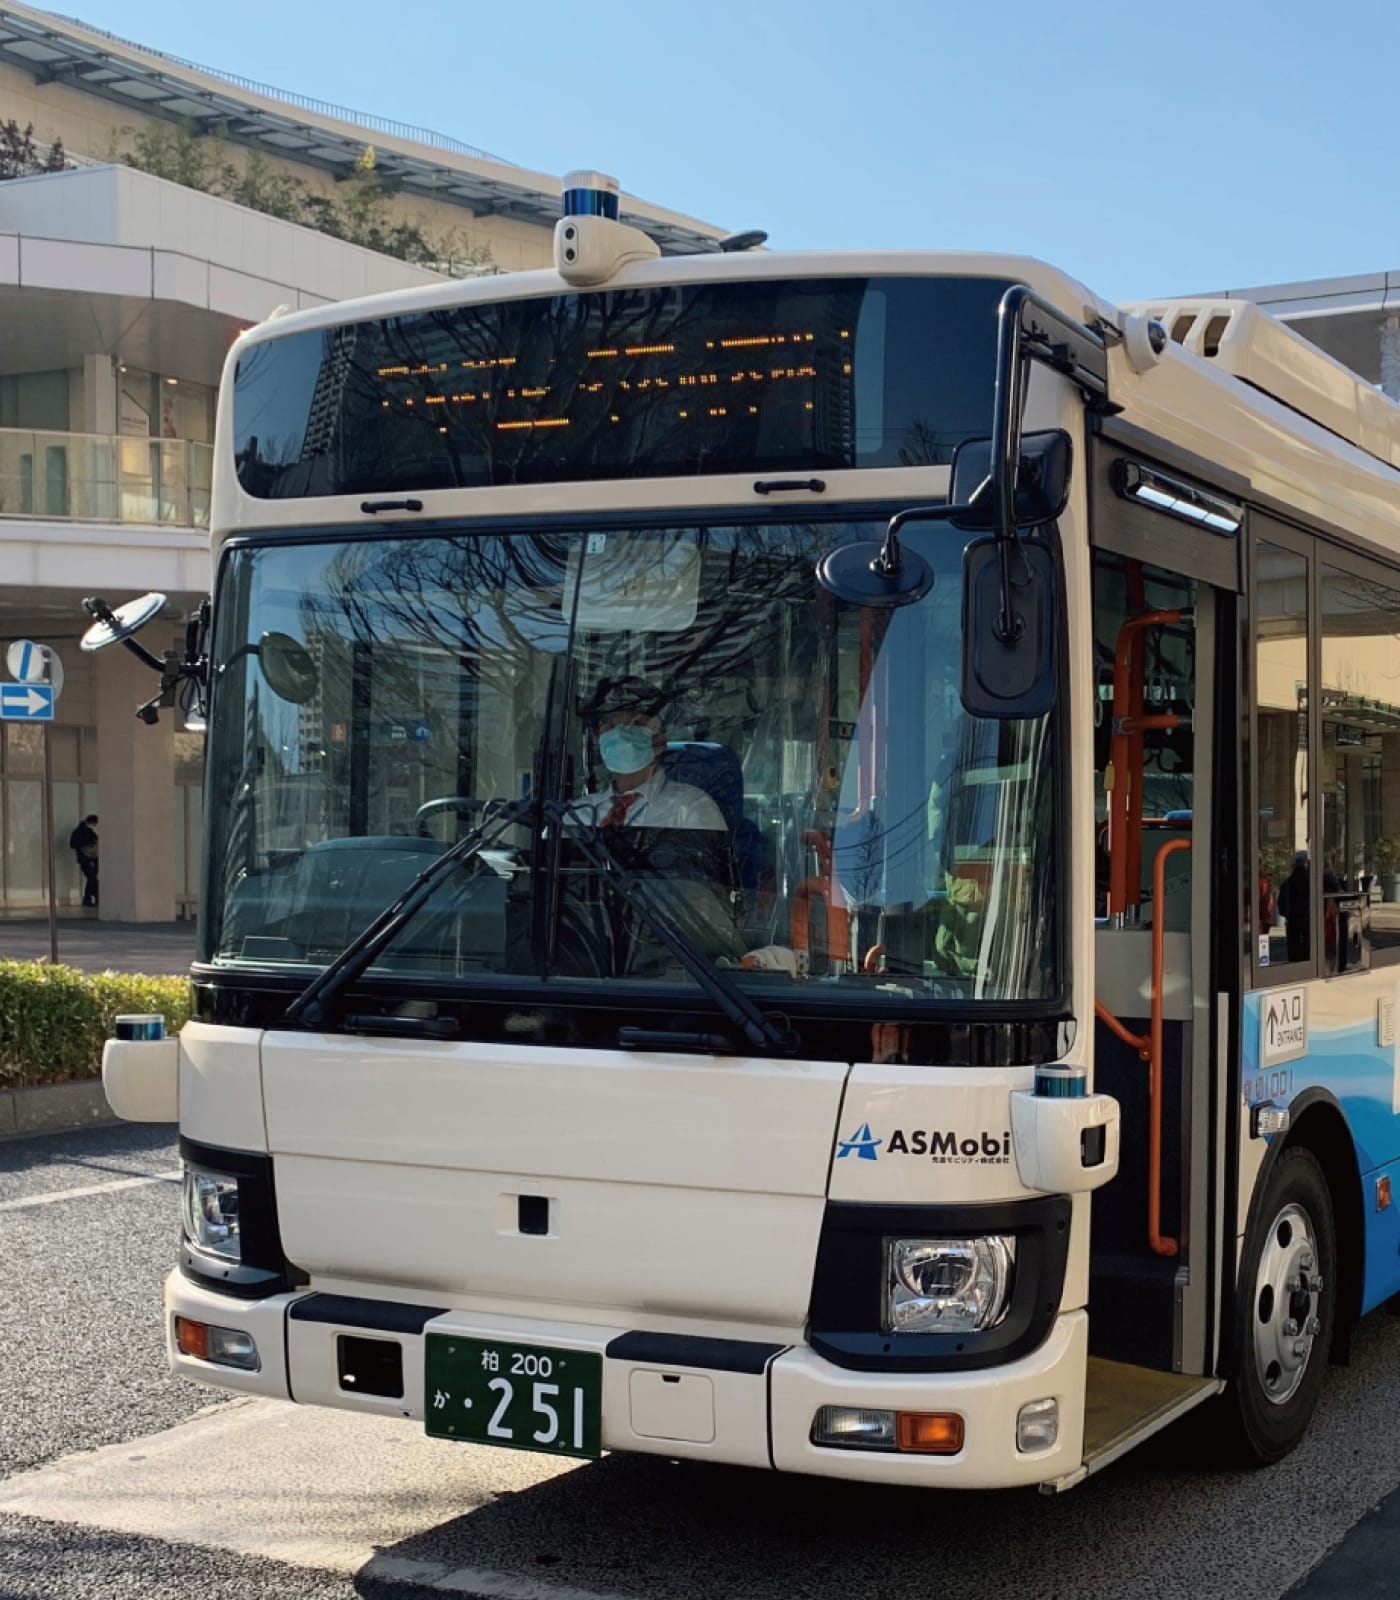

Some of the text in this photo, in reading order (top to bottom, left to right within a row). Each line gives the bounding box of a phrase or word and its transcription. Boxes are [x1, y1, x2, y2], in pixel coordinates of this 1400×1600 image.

[1280, 995, 1301, 1025] 入口
[1277, 1026, 1303, 1047] ENTRANCE
[886, 1130, 1011, 1157] ASMobi
[481, 1350, 552, 1378] 柏 200
[433, 1389, 450, 1409] か
